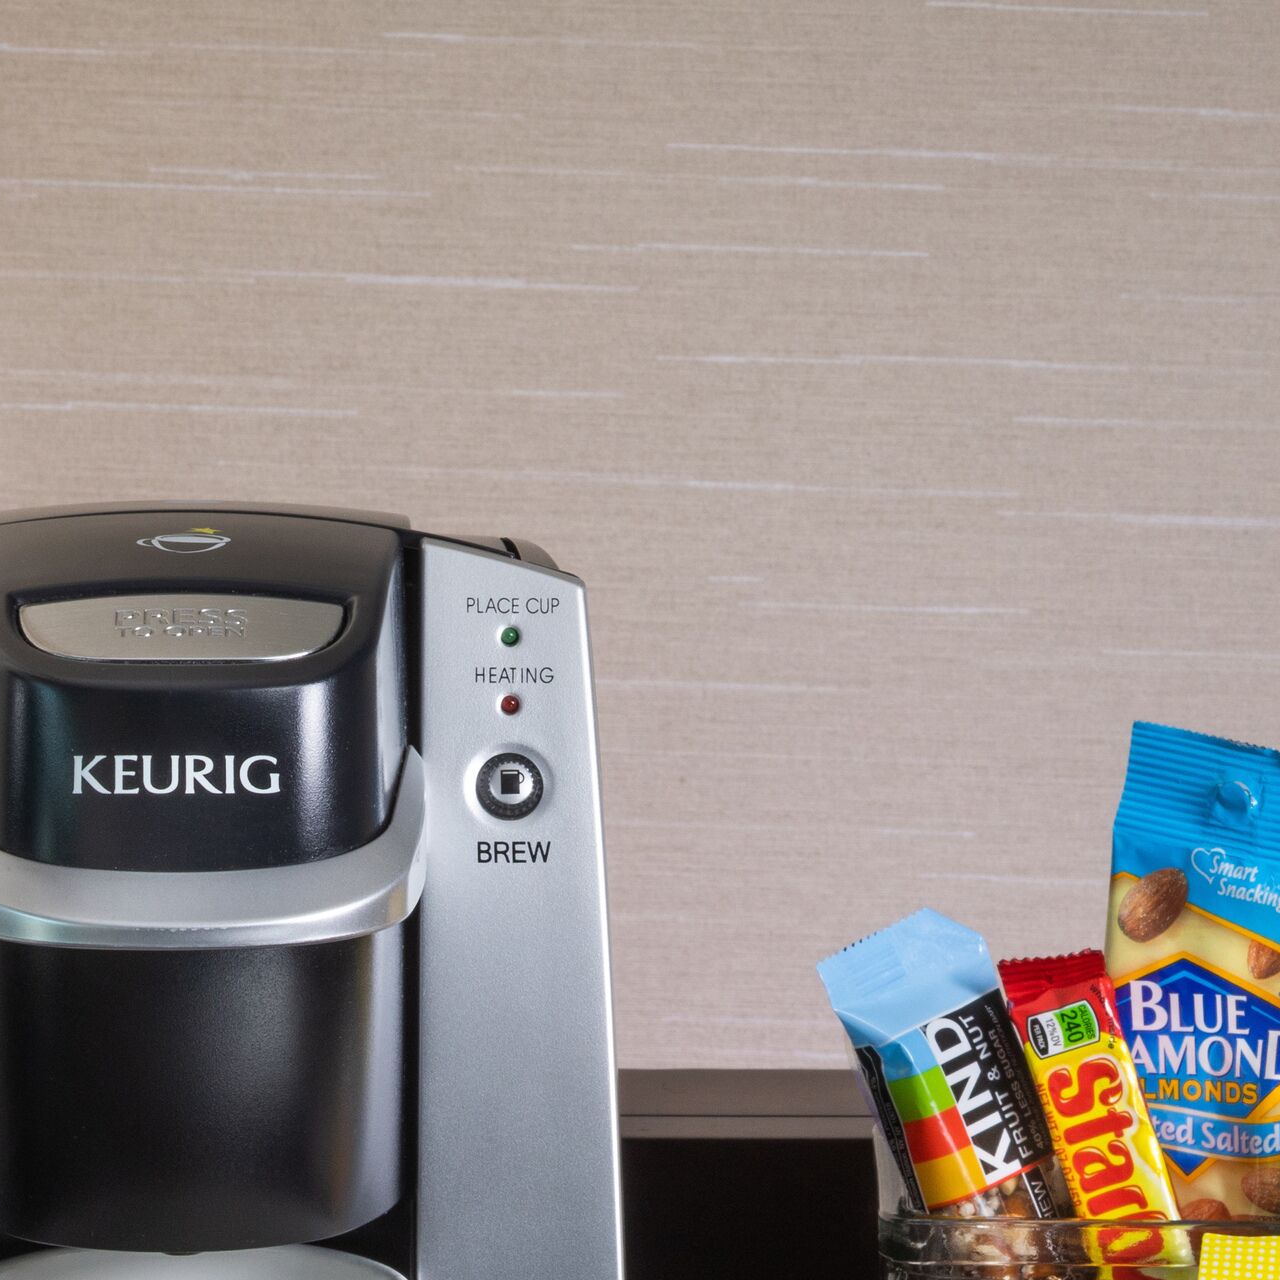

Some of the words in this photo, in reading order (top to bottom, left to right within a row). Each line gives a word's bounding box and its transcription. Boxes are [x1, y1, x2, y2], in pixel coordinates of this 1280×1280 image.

[114, 607, 248, 626] PRESS
[466, 597, 519, 614] PLACE
[525, 597, 560, 614] CUP
[115, 624, 153, 638] TO
[163, 624, 247, 638] OPEN
[475, 667, 554, 684] HEATING
[72, 754, 281, 795] KEURIG
[477, 841, 551, 863] BREW
[1209, 854, 1258, 882] Smart
[1078, 1003, 1096, 1040] CALORIES
[1130, 980, 1250, 1035] BLUE
[959, 1014, 993, 1060] NUT
[1059, 1008, 1085, 1044] 240
[988, 1031, 1015, 1079] SUGAR
[987, 1066, 1001, 1082] &
[1140, 1078, 1258, 1105] LMONDS
[925, 1017, 1022, 1185] KIND
[1011, 1080, 1033, 1123] LESS
[994, 1090, 1032, 1159] FRUIT
